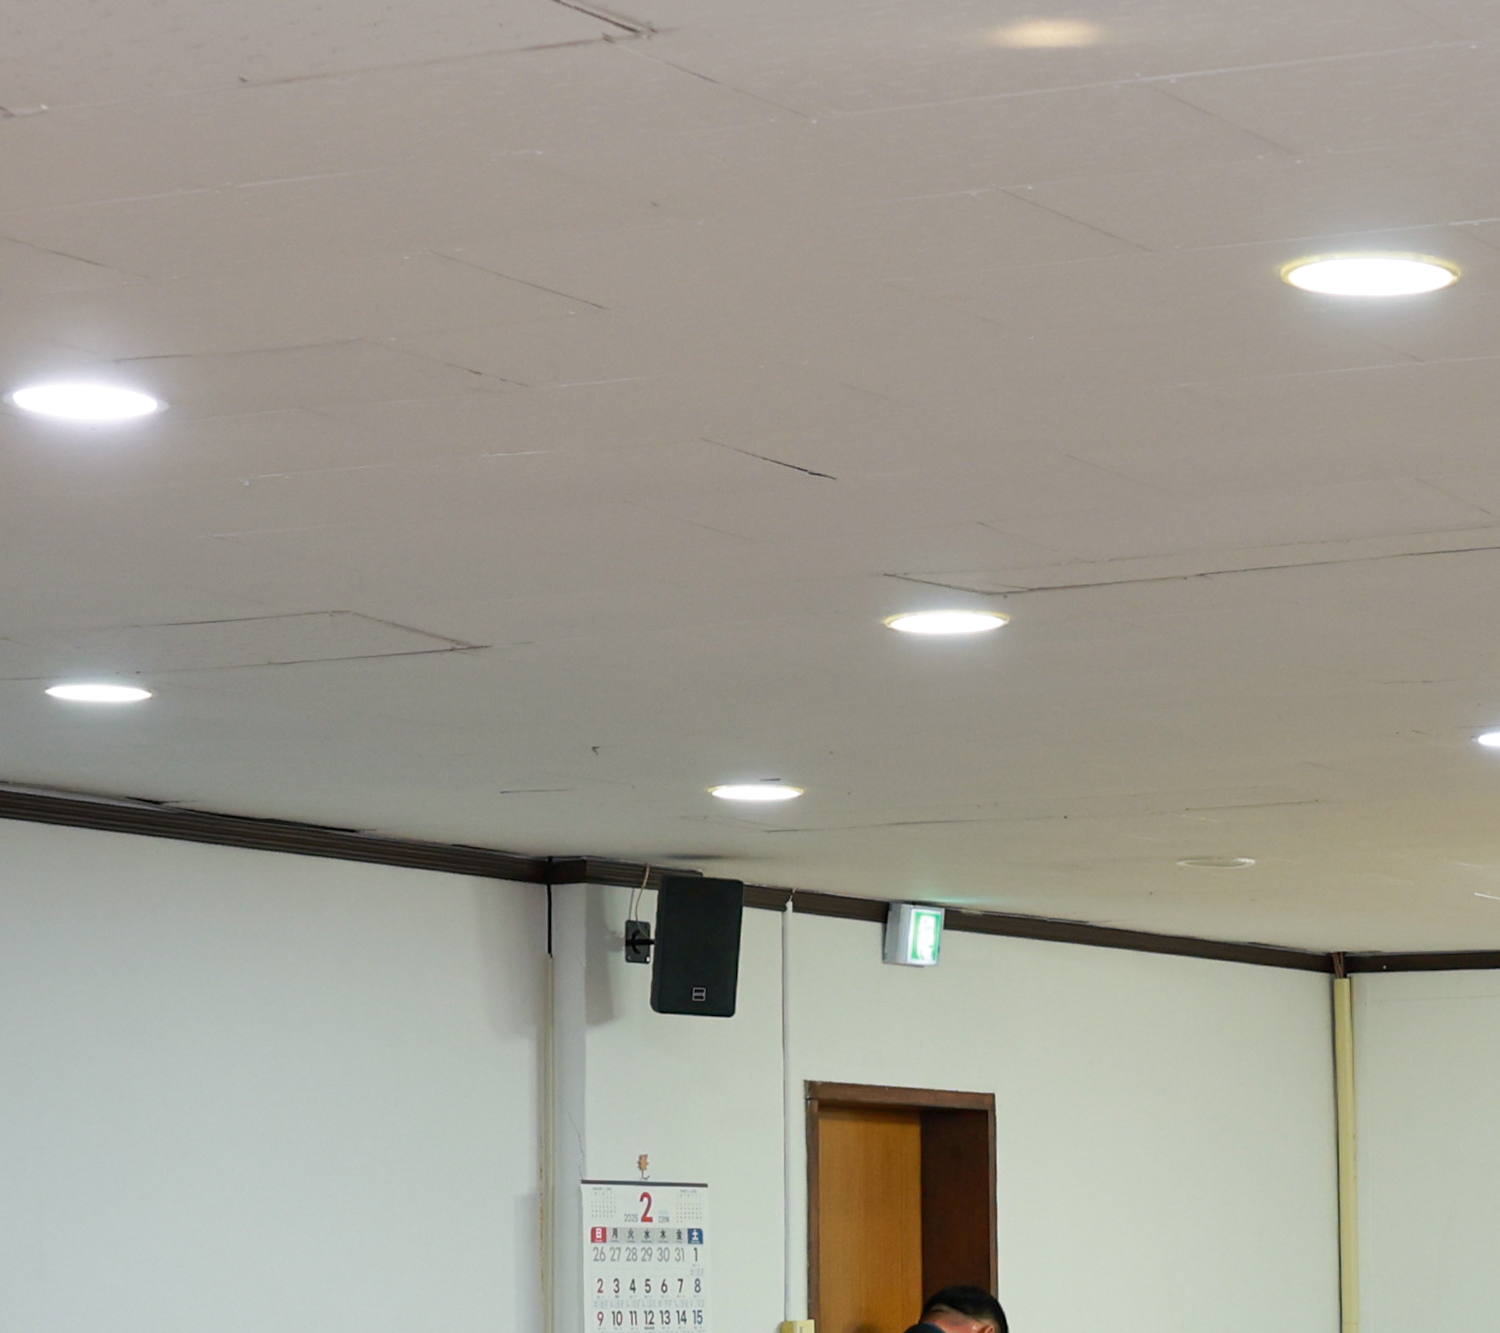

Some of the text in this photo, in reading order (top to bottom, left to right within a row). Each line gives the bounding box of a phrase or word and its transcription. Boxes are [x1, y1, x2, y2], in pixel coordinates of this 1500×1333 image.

[639, 1191, 653, 1223] 2
[593, 1246, 698, 1262] 26 27 28 29 30 31 1
[597, 1278, 701, 1293] 2 3 4 5 6 7 8
[597, 1310, 703, 1326] 9 10 11 12 13 14 15
